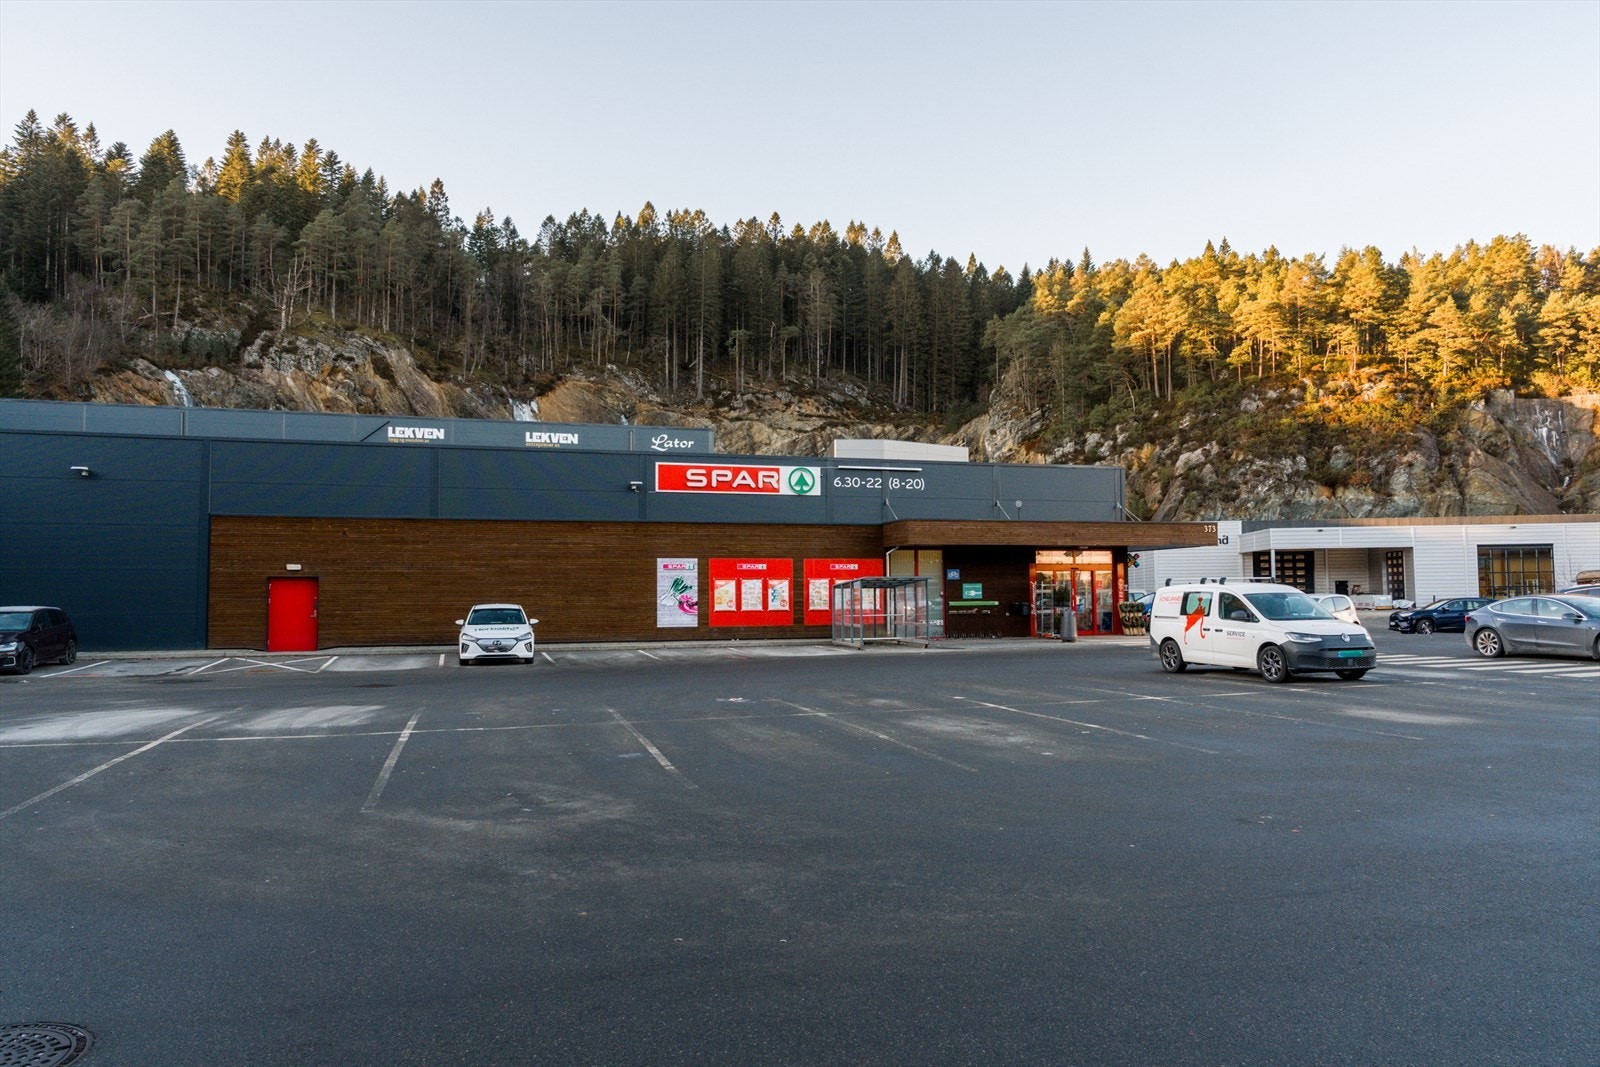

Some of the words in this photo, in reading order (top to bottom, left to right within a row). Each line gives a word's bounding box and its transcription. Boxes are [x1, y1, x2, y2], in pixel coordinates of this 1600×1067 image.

[388, 426, 445, 440] LEKVEN
[525, 431, 579, 444] LEKVEN
[651, 434, 695, 452] Lator
[685, 468, 780, 489] SPAR
[833, 476, 882, 489] 6.30-22
[888, 476, 925, 491] (8-20)
[1203, 525, 1217, 533] 373
